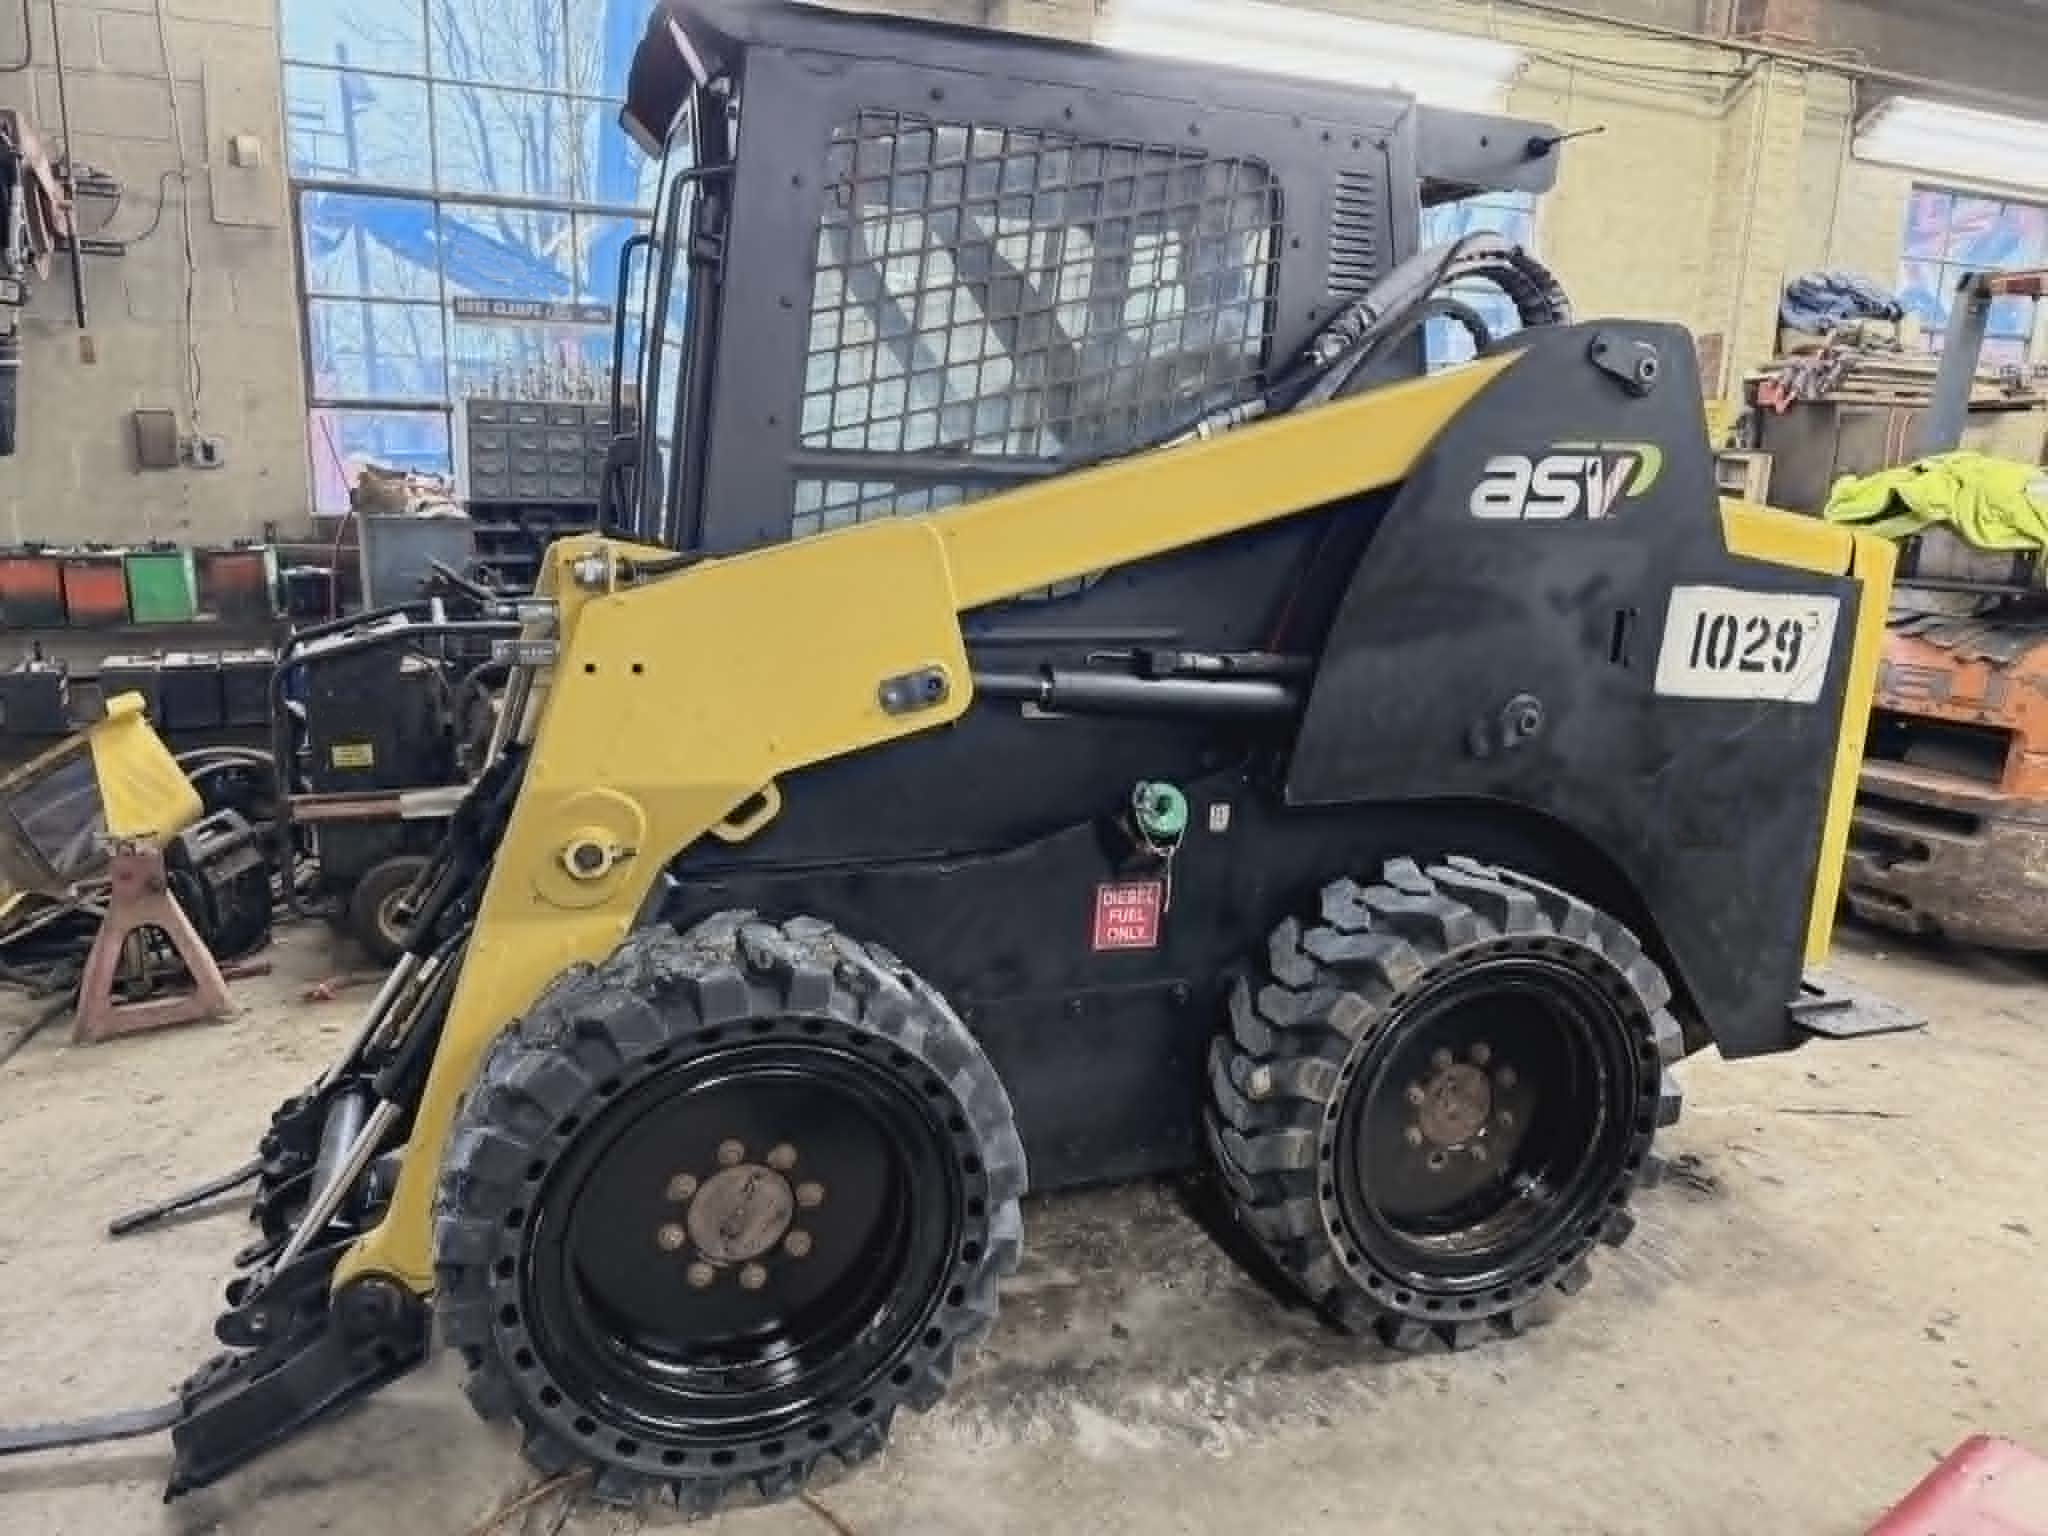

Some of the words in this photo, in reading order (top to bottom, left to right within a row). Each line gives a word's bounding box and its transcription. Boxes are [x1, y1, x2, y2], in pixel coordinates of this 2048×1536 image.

[1688, 611, 1803, 673] 1029
[1103, 888, 1153, 905] DIESEL
[1109, 908, 1145, 923] FUEL
[1106, 926, 1145, 940] ONLY
